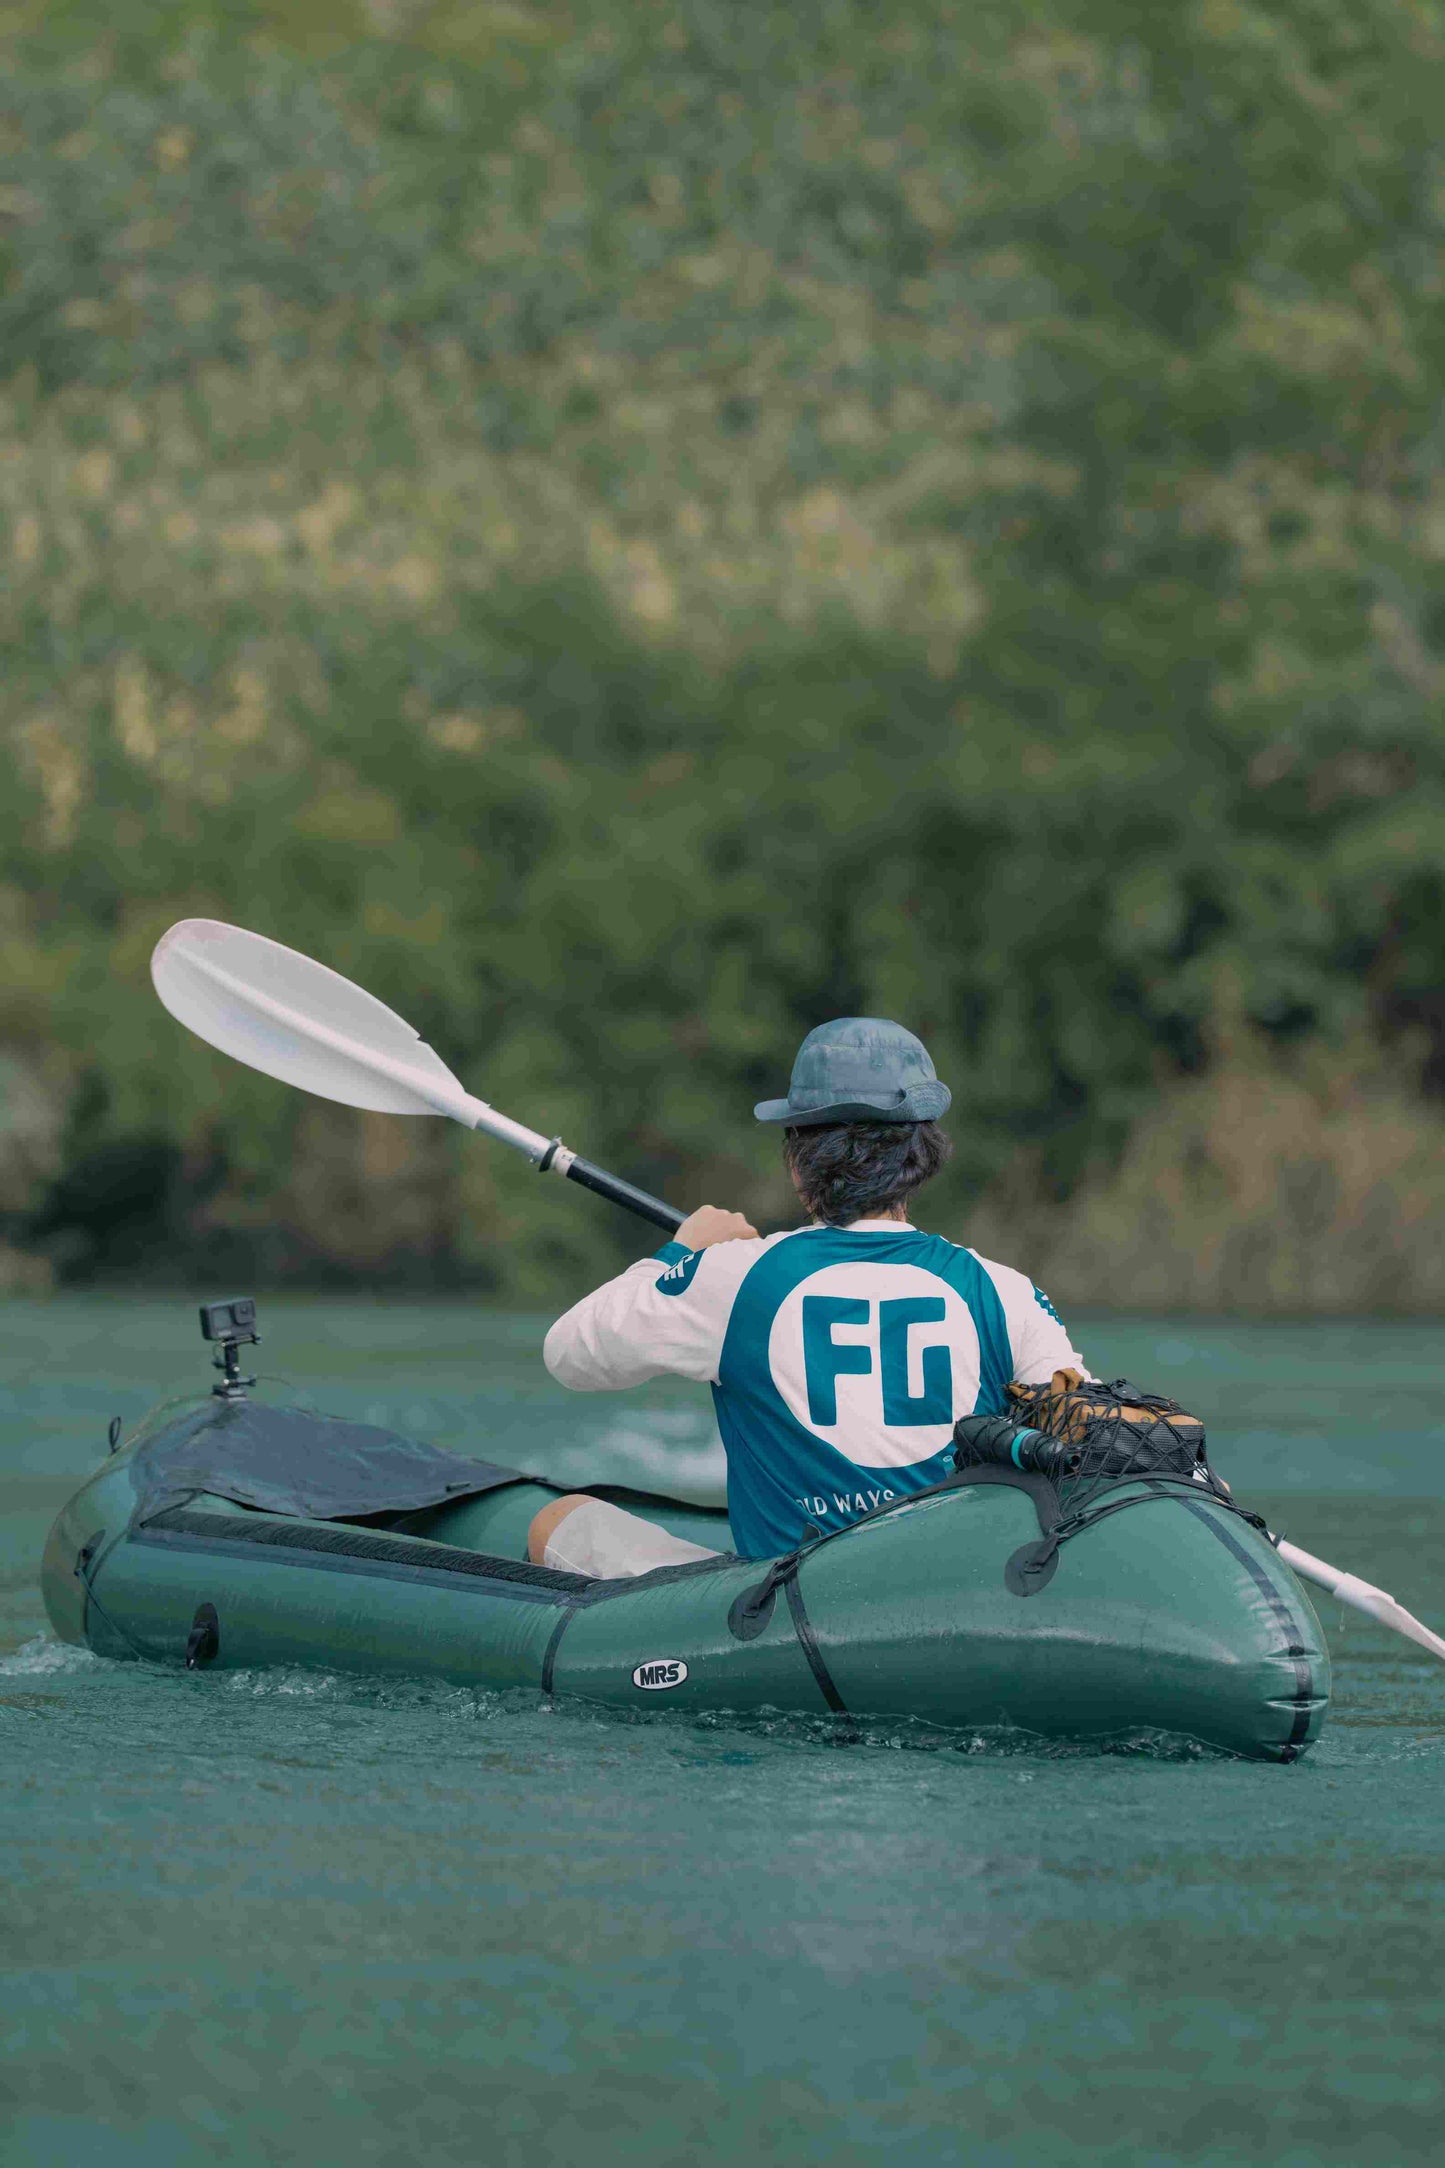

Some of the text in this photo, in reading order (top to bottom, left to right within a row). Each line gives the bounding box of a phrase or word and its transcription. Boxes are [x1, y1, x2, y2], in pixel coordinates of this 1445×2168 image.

[802, 1295, 953, 1426] FG
[832, 1489, 895, 1514] WAYS
[639, 1662, 681, 1686] MRS
